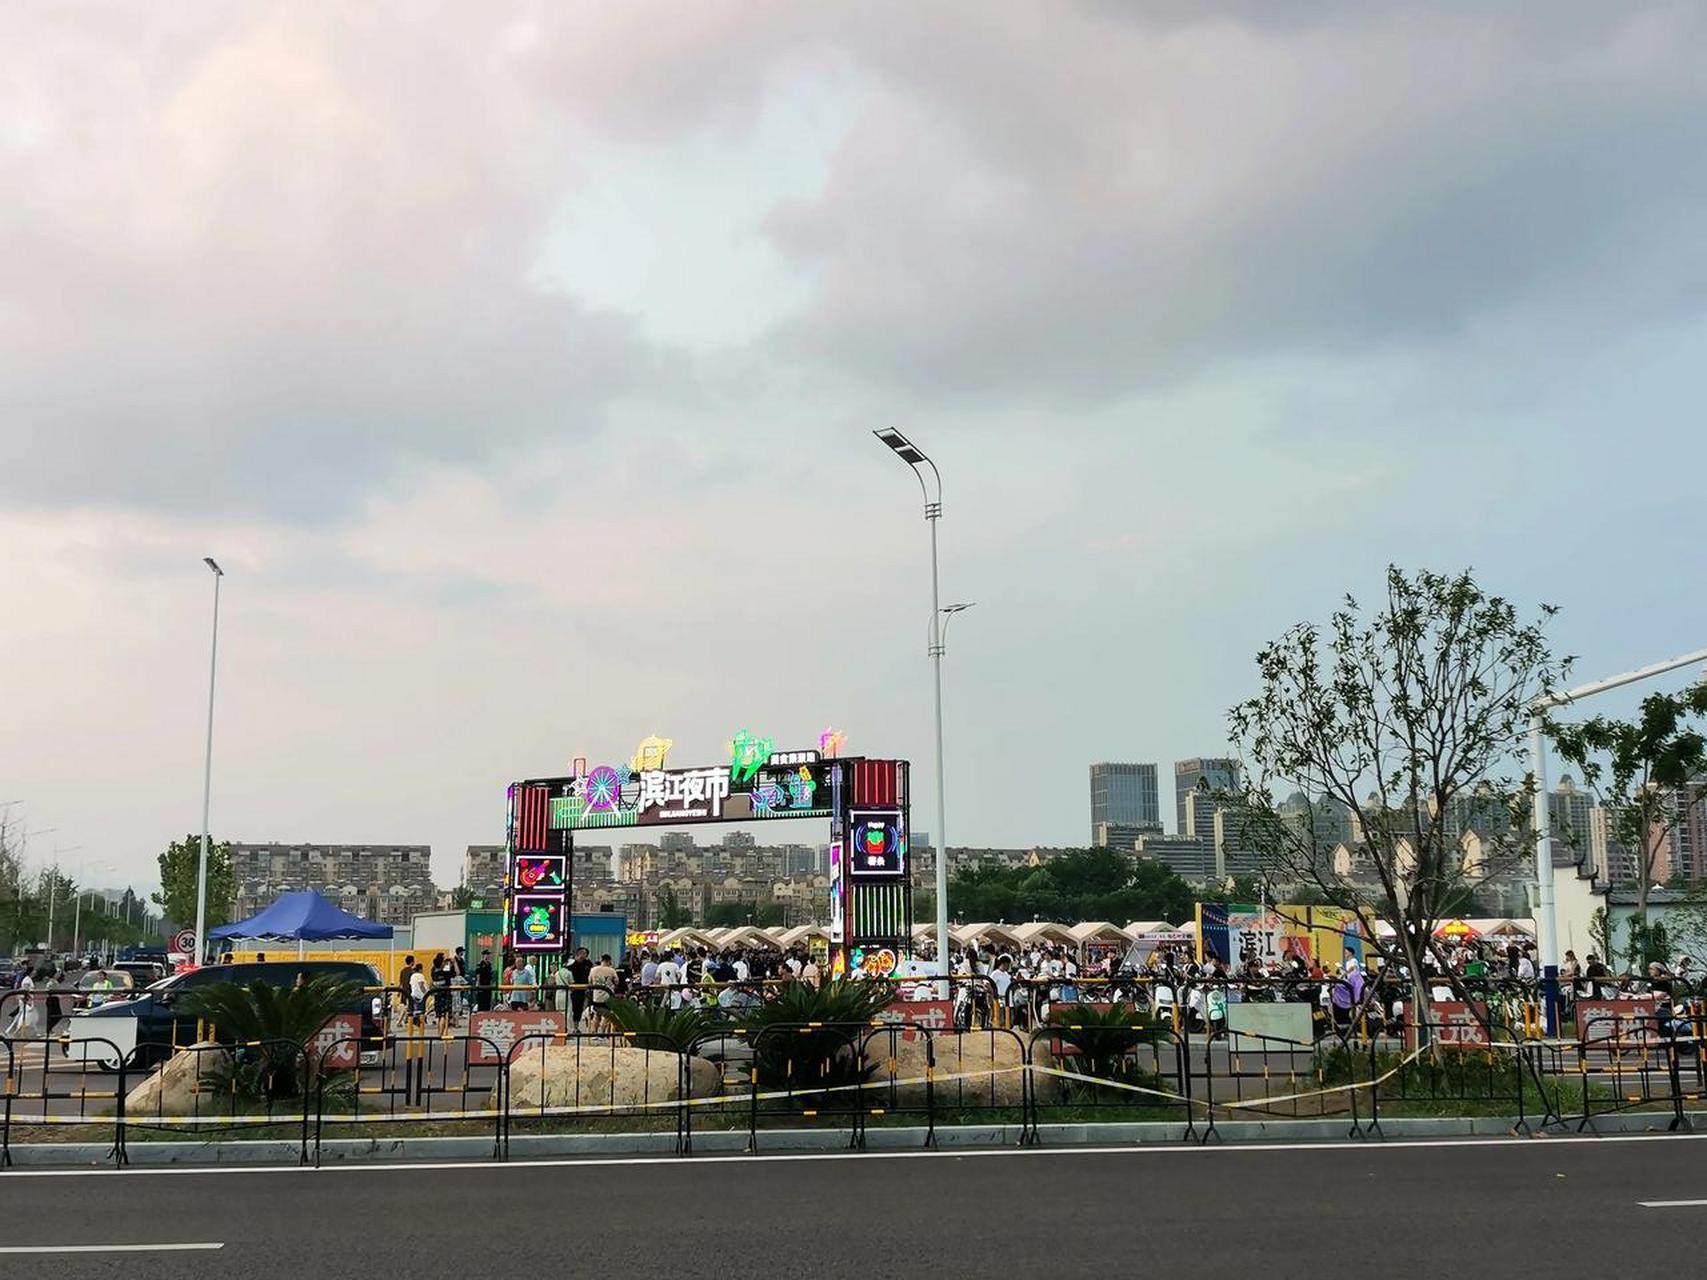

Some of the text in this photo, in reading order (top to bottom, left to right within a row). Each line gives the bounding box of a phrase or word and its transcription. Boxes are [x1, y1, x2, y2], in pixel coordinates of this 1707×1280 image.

[638, 767, 730, 817] 滨江夜市
[181, 937, 196, 948] 30
[478, 1018, 559, 1058] 警戒
